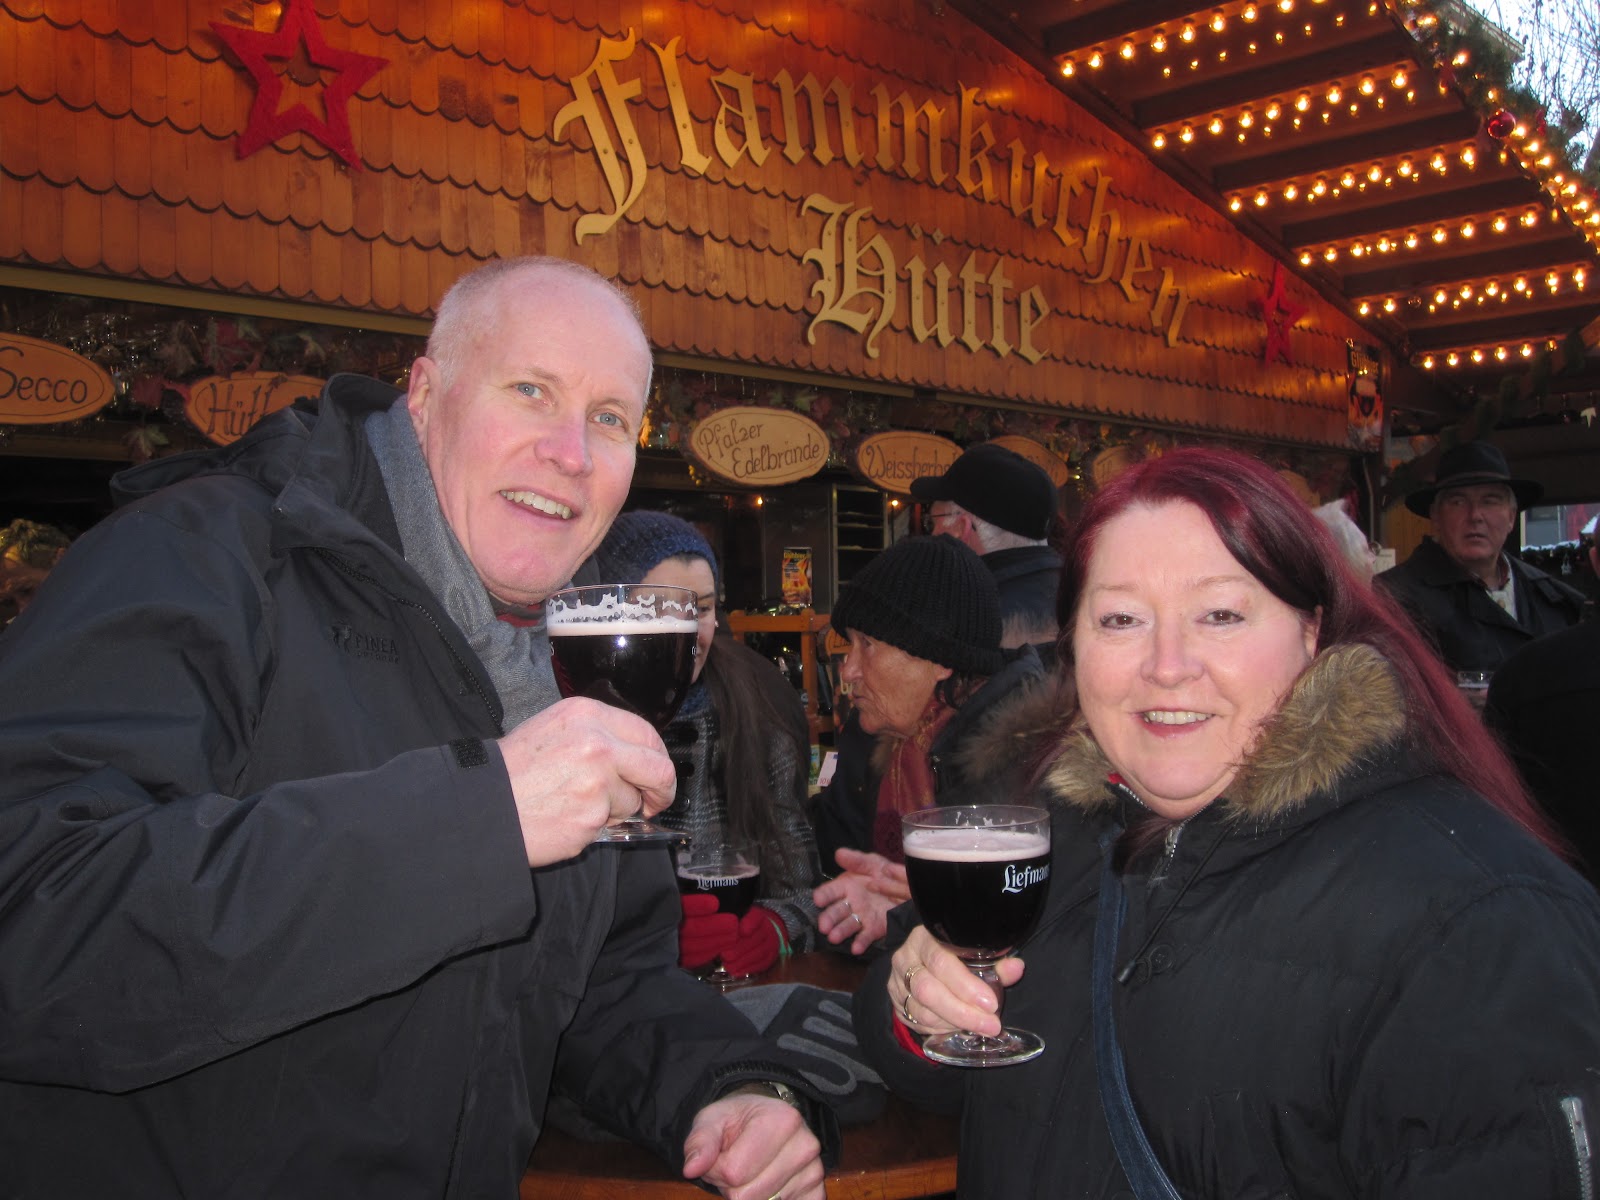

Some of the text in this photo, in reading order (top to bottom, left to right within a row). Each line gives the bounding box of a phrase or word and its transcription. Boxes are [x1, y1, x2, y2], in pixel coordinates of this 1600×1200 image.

[554, 27, 1196, 348] Flammkuchen
[801, 193, 1051, 365] Hütte
[0, 346, 88, 404] Secco
[732, 433, 820, 478] Edelbrände
[865, 444, 957, 479] Weissherb
